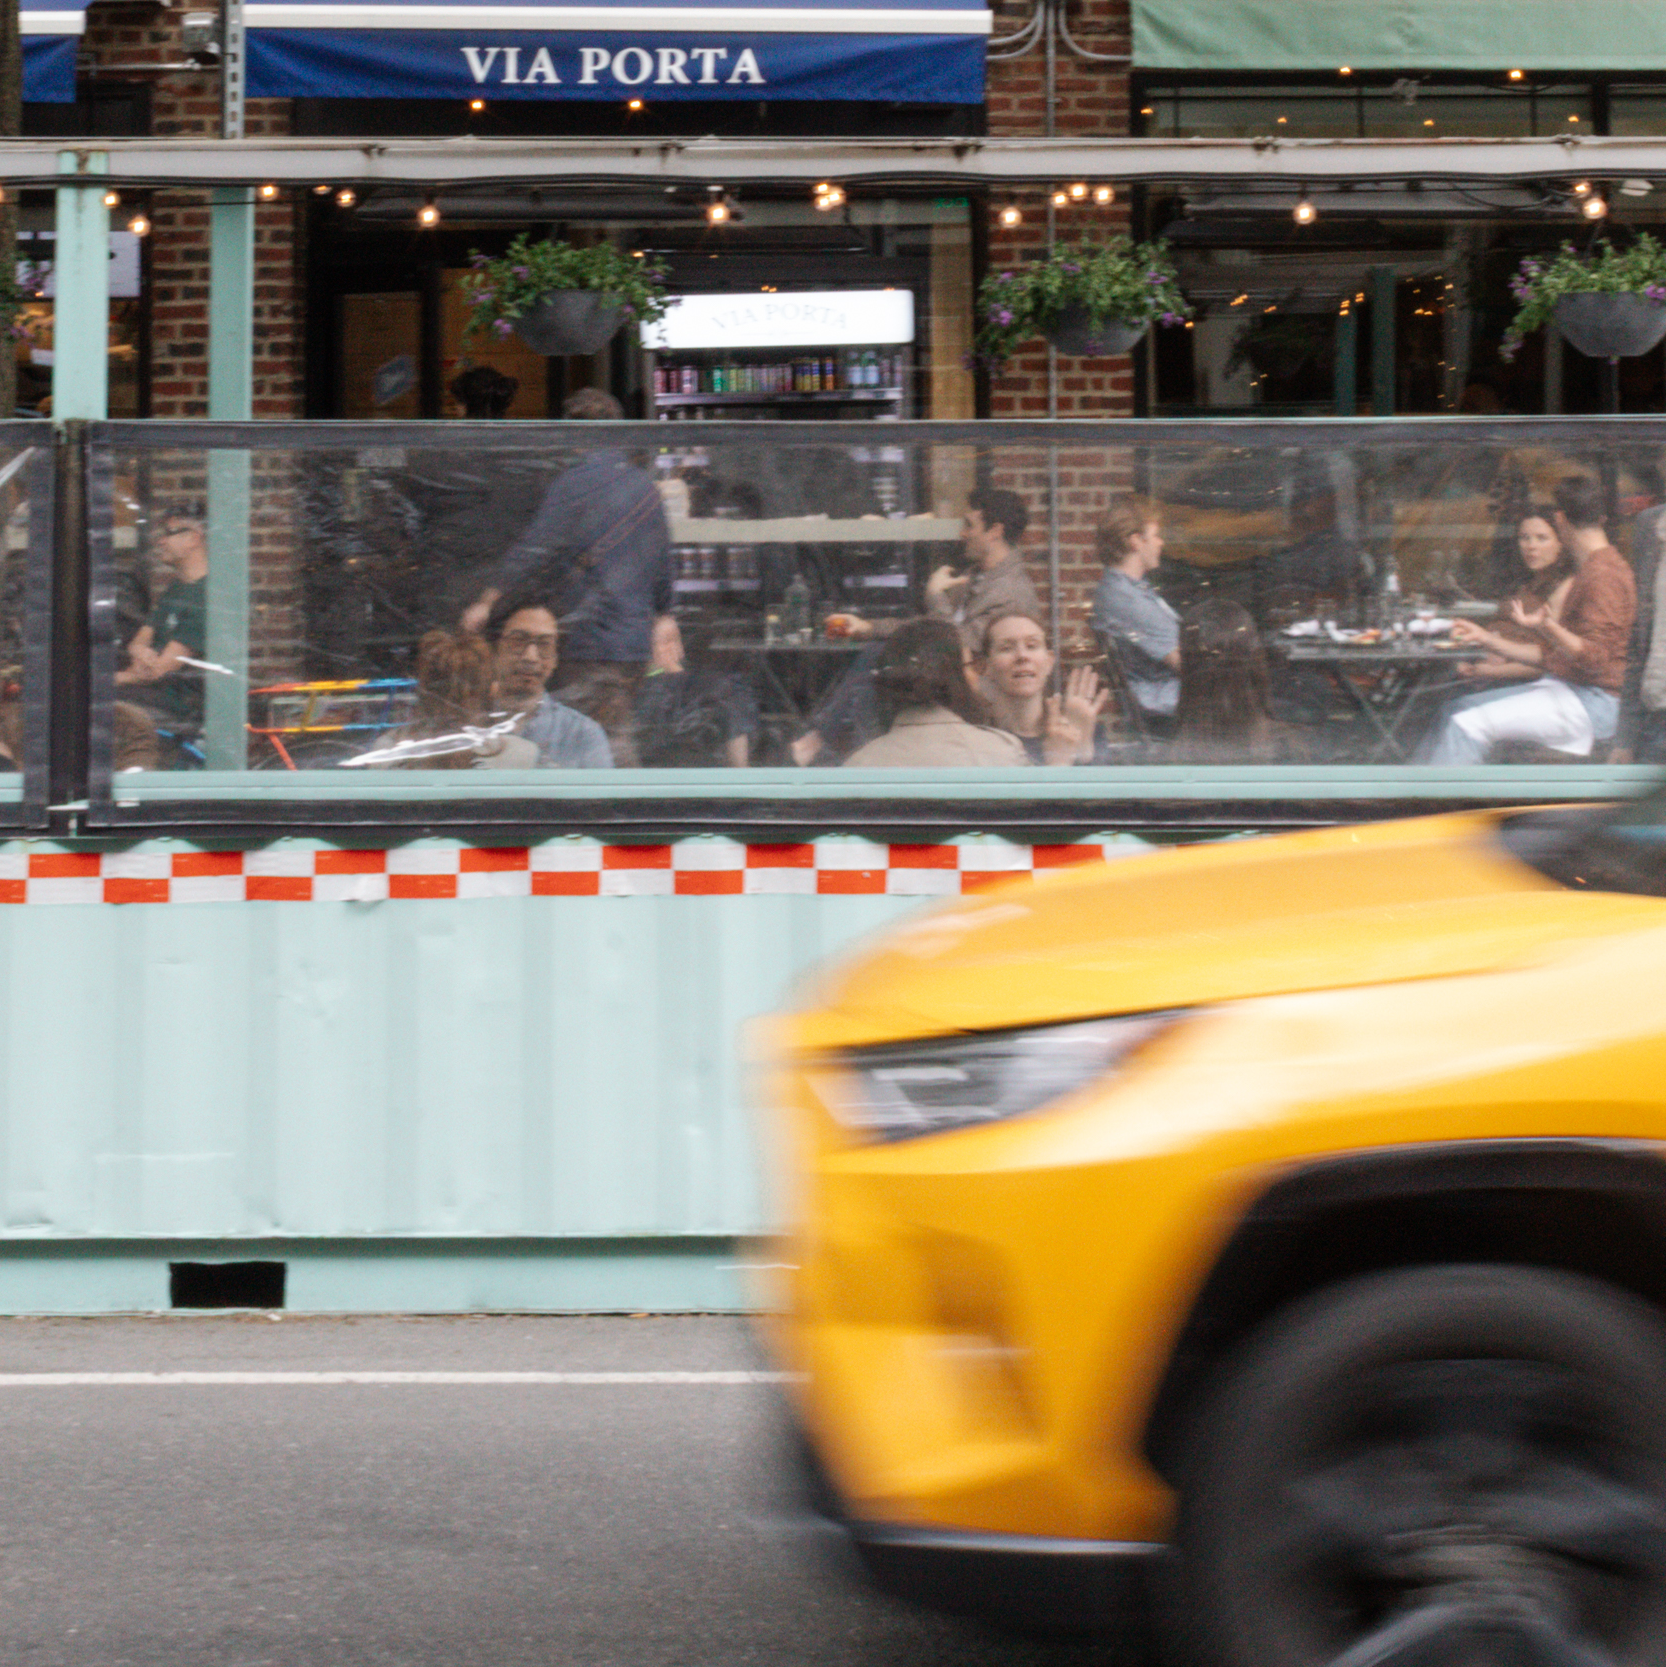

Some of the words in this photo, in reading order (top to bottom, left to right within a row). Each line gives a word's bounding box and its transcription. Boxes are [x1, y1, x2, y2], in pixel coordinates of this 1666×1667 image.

[460, 47, 562, 84] VIA
[577, 47, 766, 85] PORTA
[711, 307, 759, 329] VIA
[764, 302, 847, 330] PORTA
